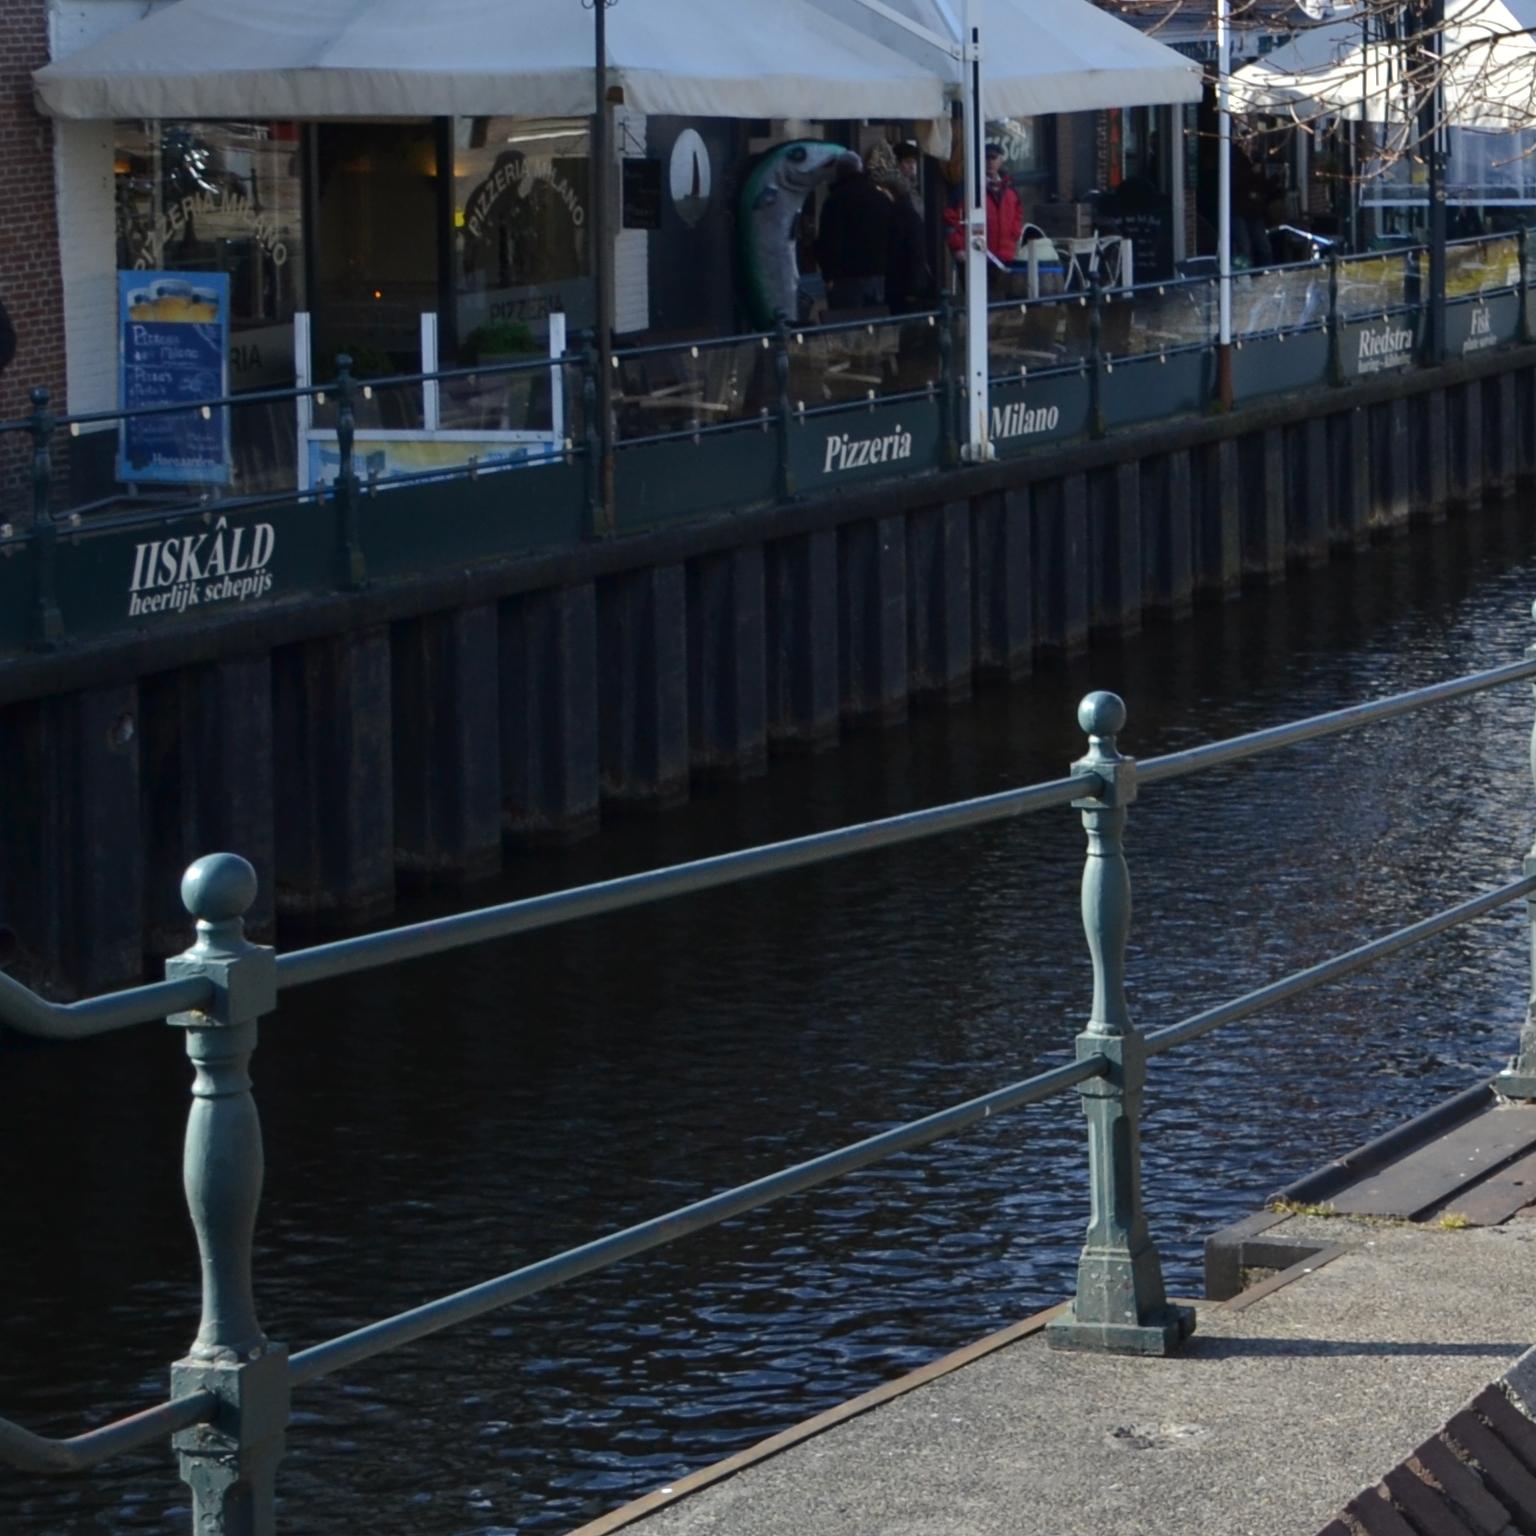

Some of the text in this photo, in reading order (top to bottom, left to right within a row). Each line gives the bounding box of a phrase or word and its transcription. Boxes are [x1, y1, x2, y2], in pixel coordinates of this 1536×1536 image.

[221, 186, 288, 266] MILANO
[467, 156, 530, 238] PIZZERIA
[533, 161, 585, 226] MILANO
[823, 424, 912, 474] Pizzeria
[990, 402, 1059, 441] Milano
[129, 516, 276, 592] IISKÂLD
[128, 568, 274, 617] heerlijk schepijs
